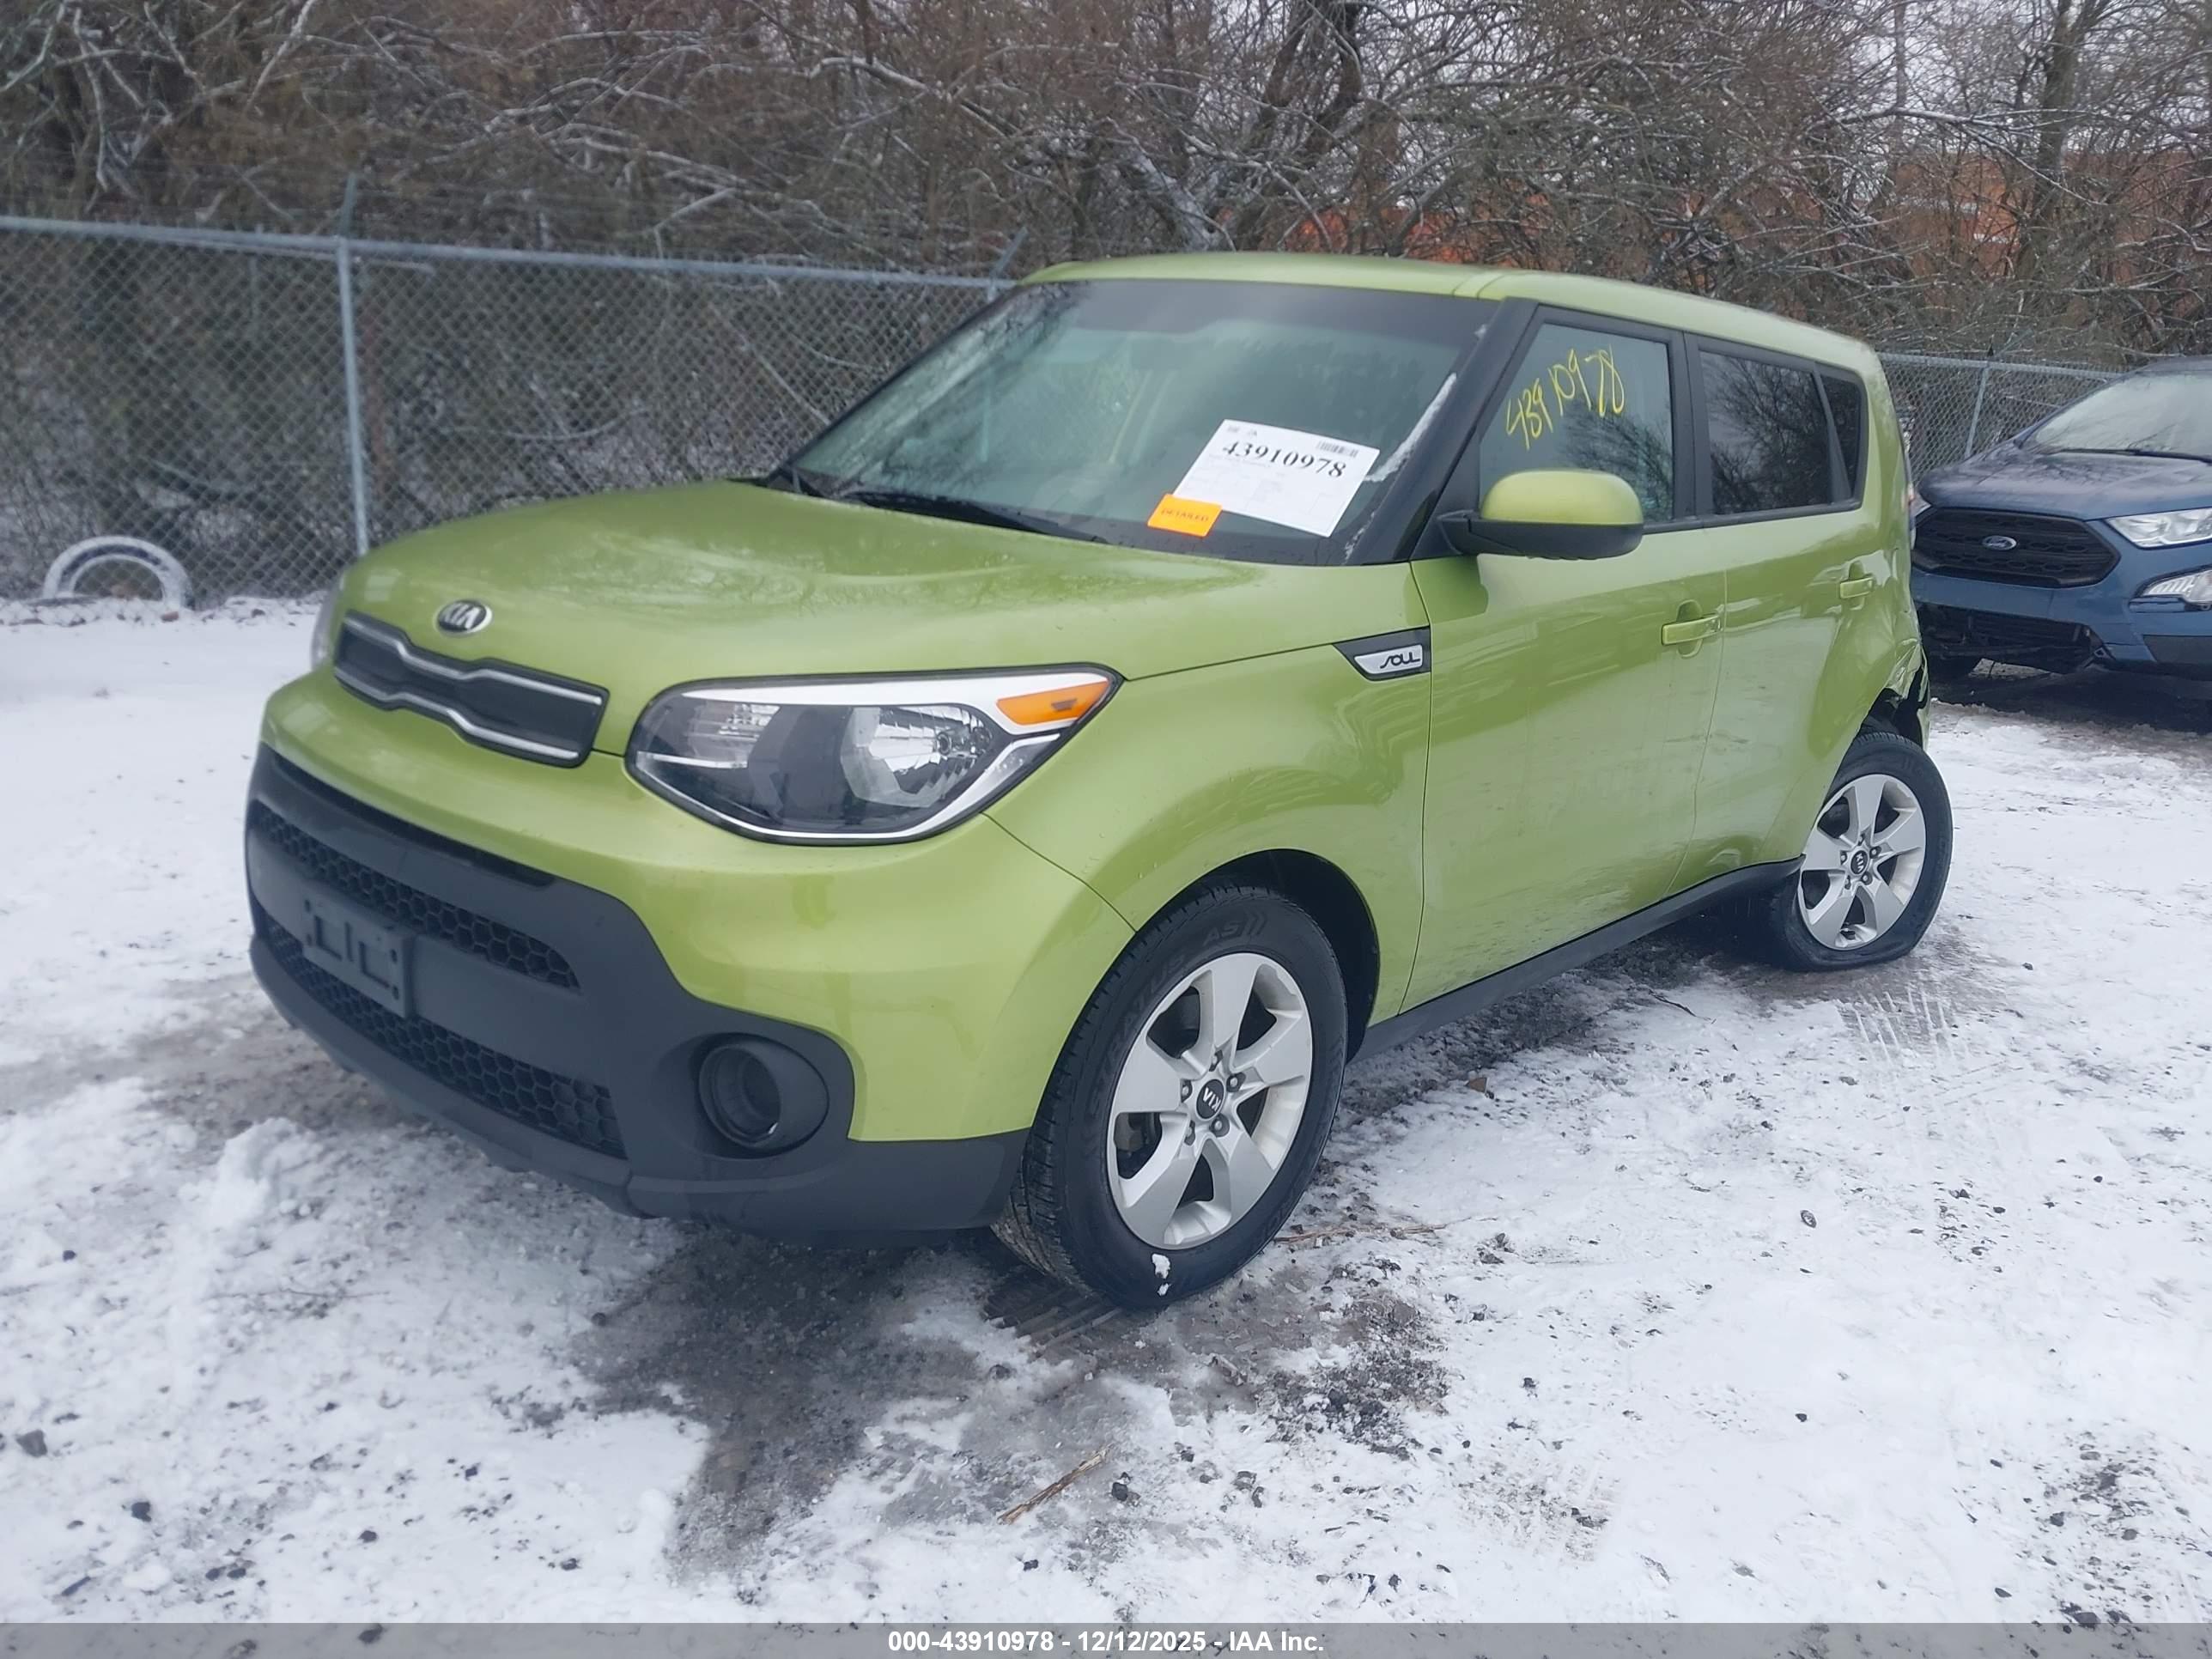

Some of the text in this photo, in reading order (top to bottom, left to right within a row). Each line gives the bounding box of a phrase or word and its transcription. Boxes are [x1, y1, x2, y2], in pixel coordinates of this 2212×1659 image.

[1506, 344, 1625, 450] 43910978
[1222, 441, 1346, 477] 43910978
[440, 603, 480, 629] KIA
[1379, 652, 1421, 669] SOUL
[1856, 853, 1864, 873] KIA
[1202, 1086, 1222, 1112] KIA
